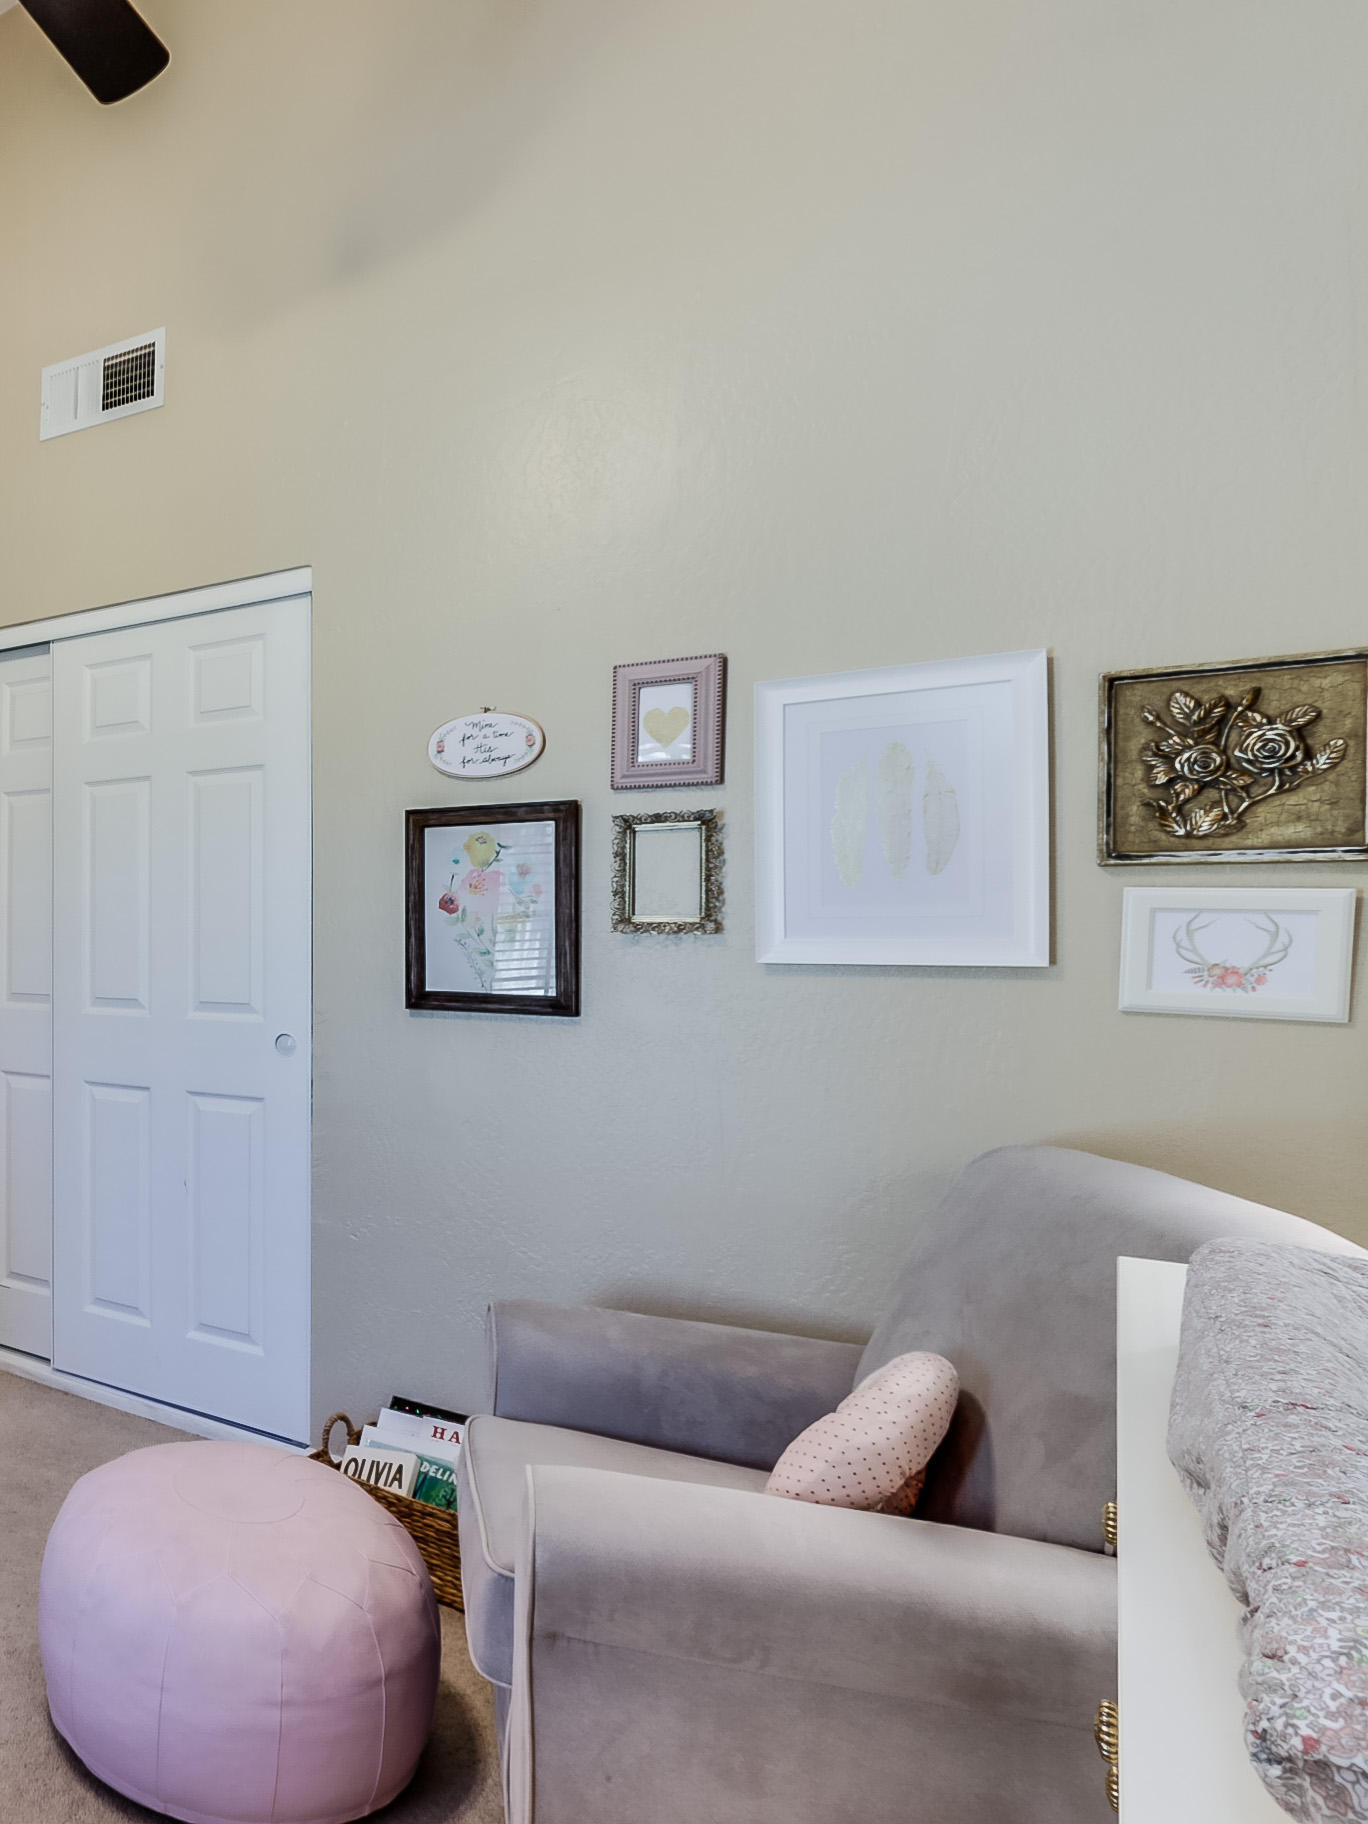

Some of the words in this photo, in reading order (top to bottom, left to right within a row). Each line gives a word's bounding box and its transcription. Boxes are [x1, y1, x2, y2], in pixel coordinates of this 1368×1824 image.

[459, 732, 479, 747] for
[459, 756, 478, 768] for
[343, 1457, 404, 1490] OLIVIA
